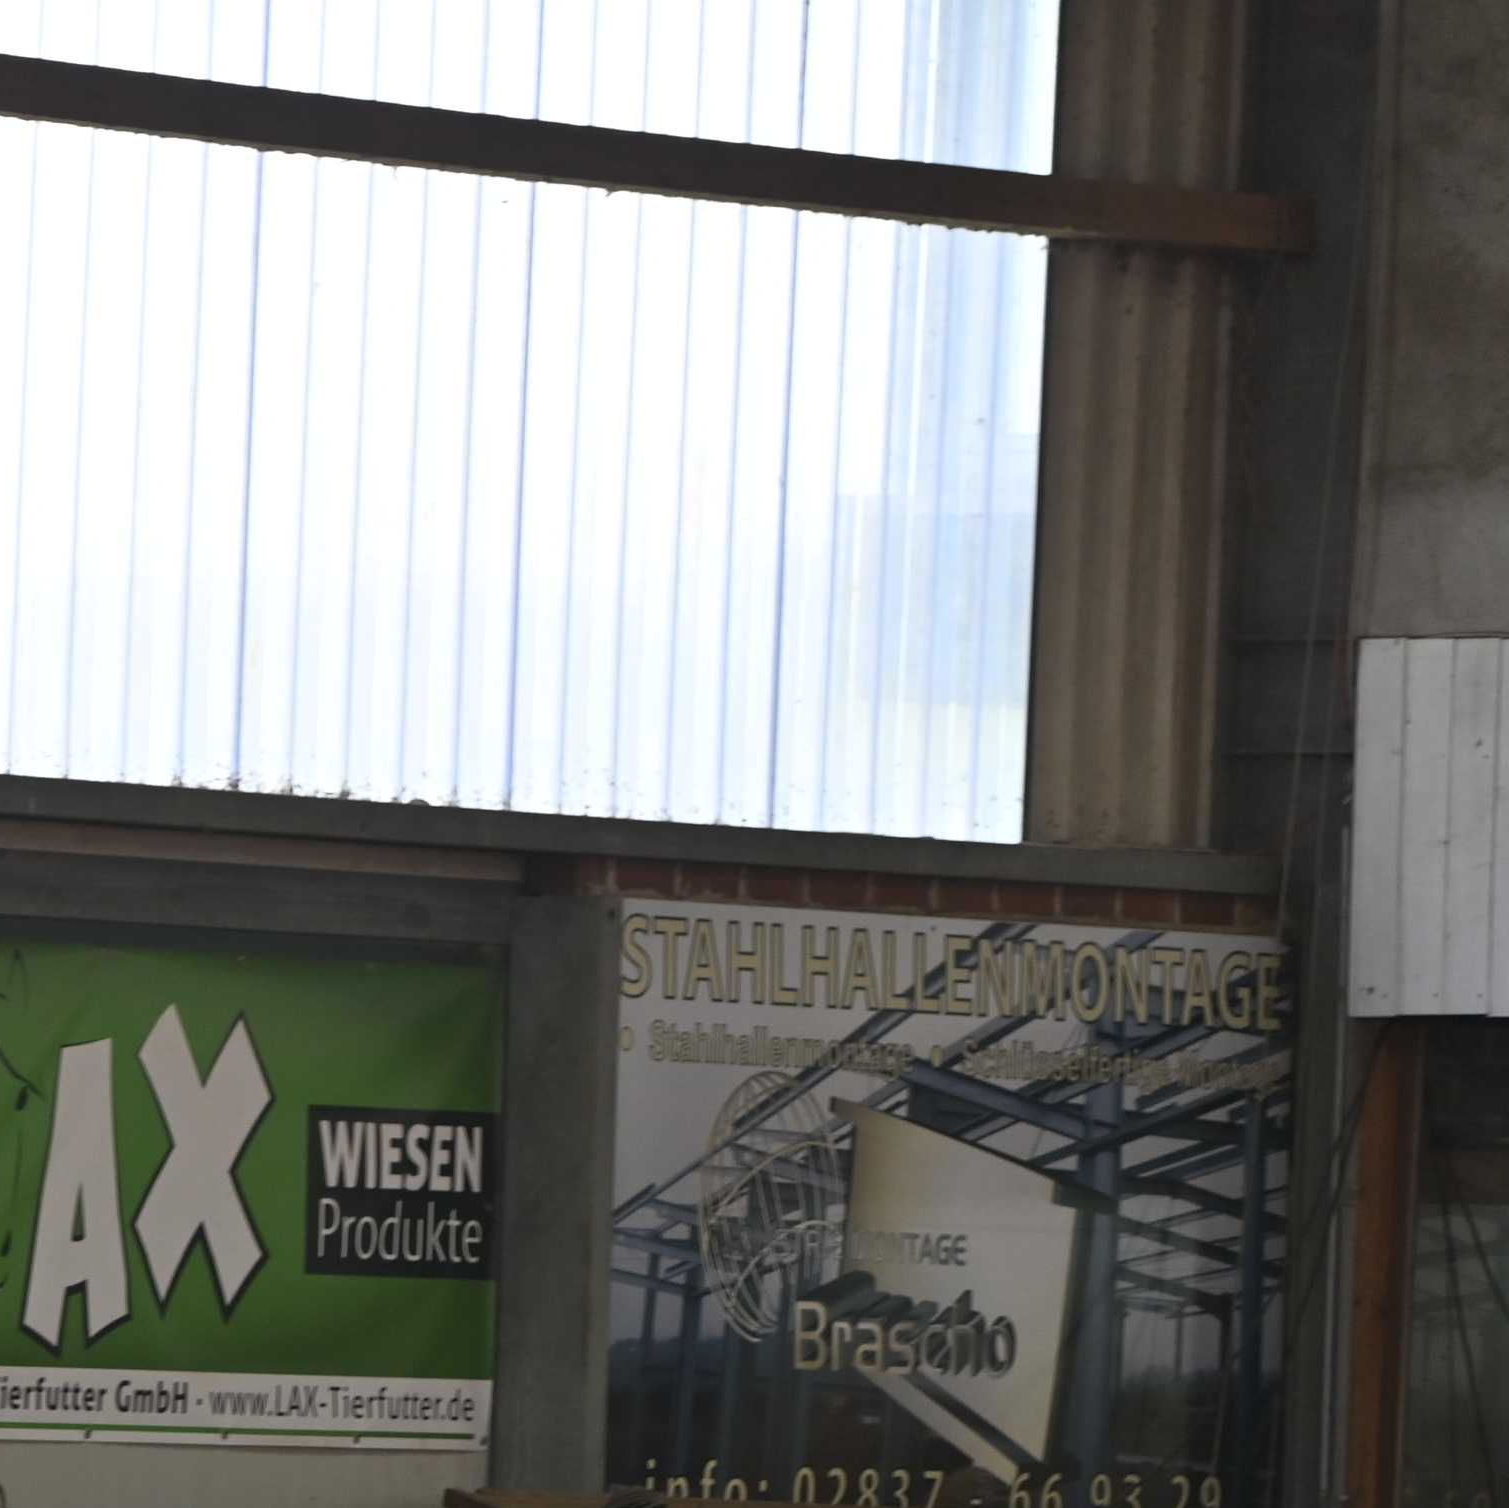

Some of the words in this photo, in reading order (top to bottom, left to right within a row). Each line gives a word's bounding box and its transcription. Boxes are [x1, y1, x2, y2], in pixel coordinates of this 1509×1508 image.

[621, 912, 1284, 1031] STAHLHALLENMONTAGE
[318, 1119, 483, 1193] WIESEN
[317, 1196, 482, 1264] Produkte
[793, 1290, 1018, 1378] Brascho
[115, 1379, 189, 1414] GmbH
[209, 1384, 476, 1422] www.LAX-Tierfutter.de
